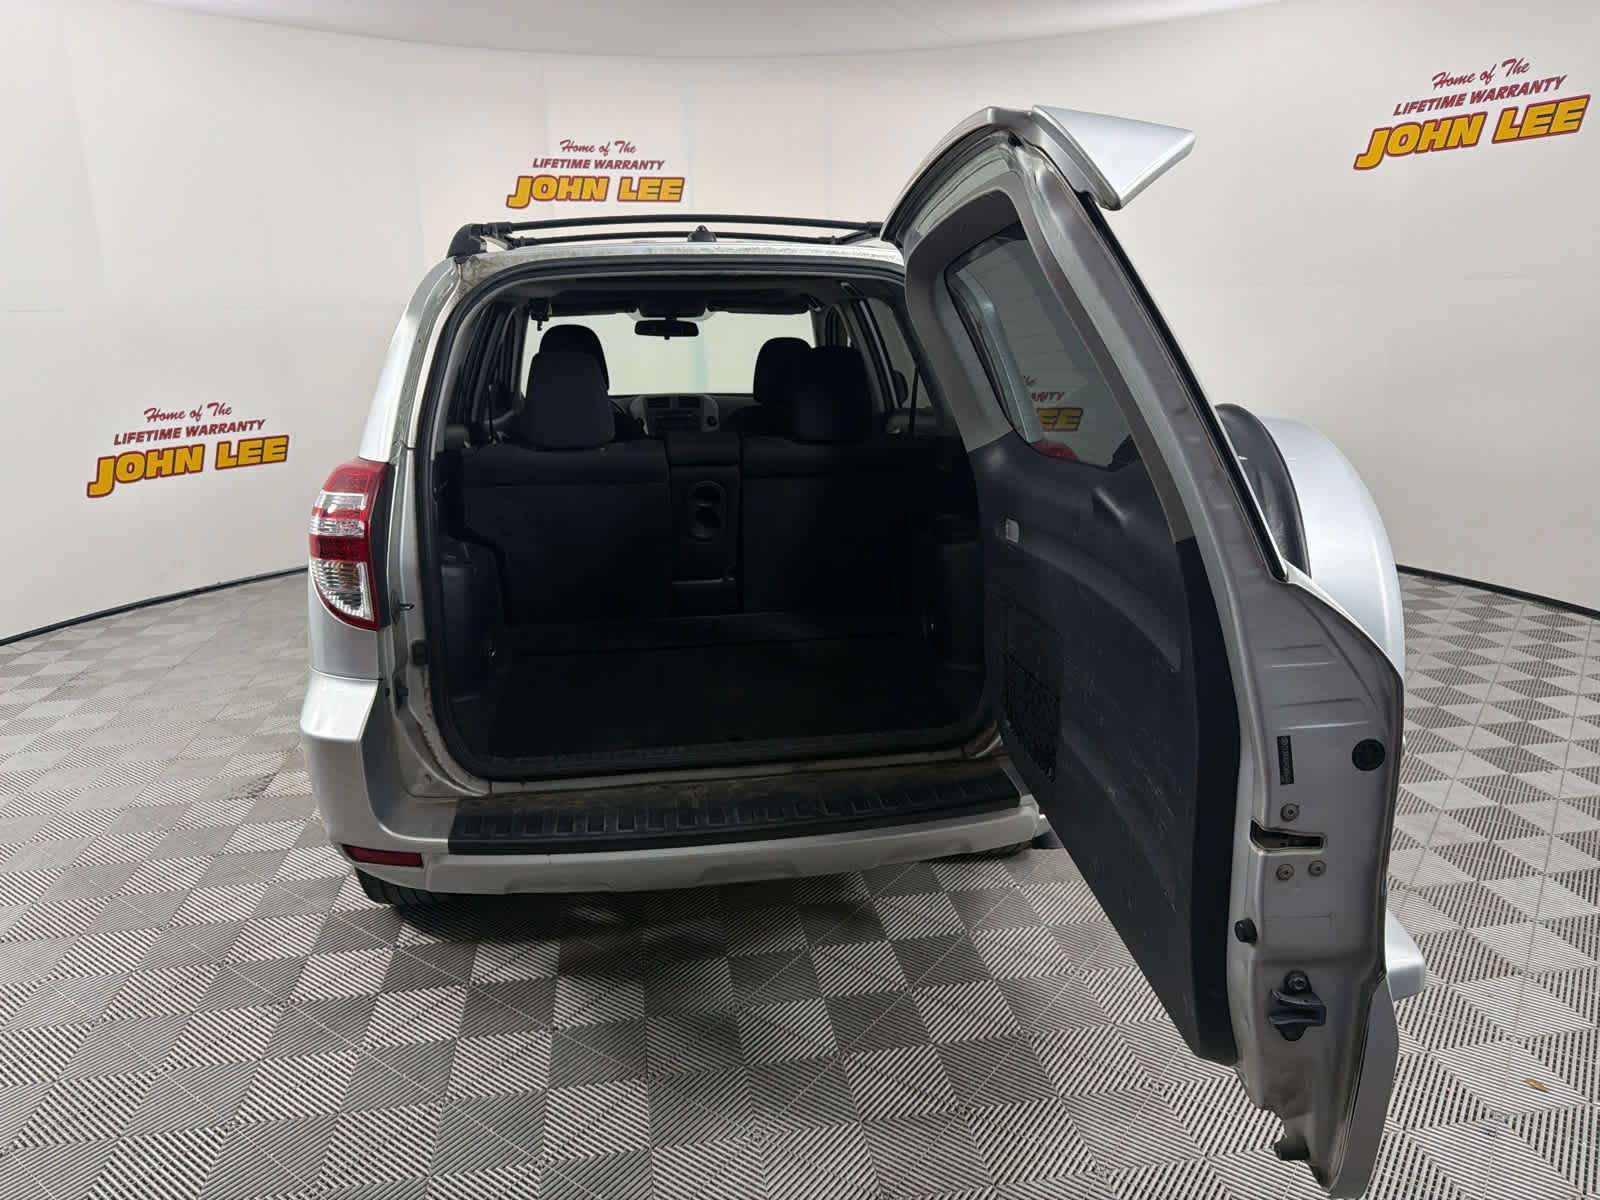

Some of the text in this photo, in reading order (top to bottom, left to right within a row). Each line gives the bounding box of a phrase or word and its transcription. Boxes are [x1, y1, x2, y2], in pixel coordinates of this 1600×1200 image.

[1431, 57, 1530, 90] Home of The
[1393, 74, 1567, 116] LIFETIME WARRANTY
[560, 139, 636, 156] Home of The
[1353, 94, 1591, 171] JOHN LEE
[532, 158, 665, 170] LIFETIME WARRANTY
[506, 175, 685, 209] JOHN LEE
[144, 402, 232, 423] Home of The
[1036, 407, 1084, 432] EE
[114, 419, 266, 446] LIFETIME WARRANTY
[87, 434, 289, 498] JOHN LEE
